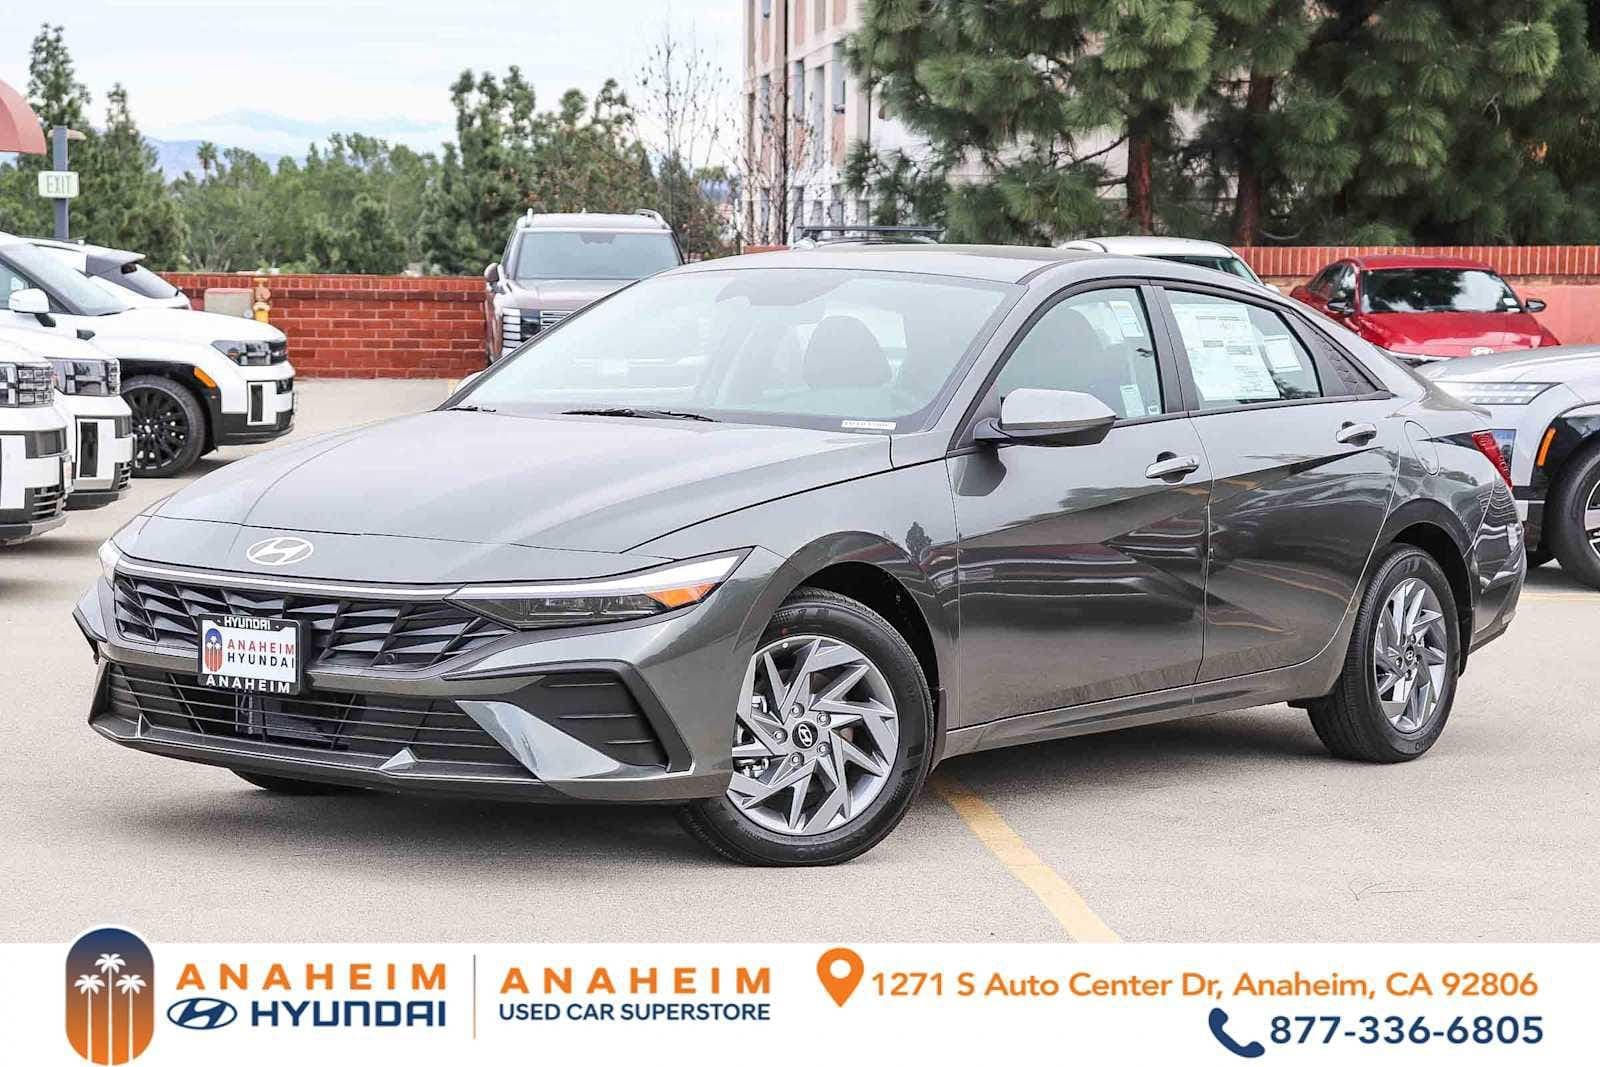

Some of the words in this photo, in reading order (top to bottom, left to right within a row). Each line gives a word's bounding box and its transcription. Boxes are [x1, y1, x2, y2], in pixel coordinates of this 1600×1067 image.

[47, 175, 72, 193] EXIT
[224, 616, 270, 630] HYUNDAI
[227, 639, 294, 655] ANAHEIM
[228, 653, 295, 668] HYUNDAI
[206, 674, 290, 694] ANAHEIM
